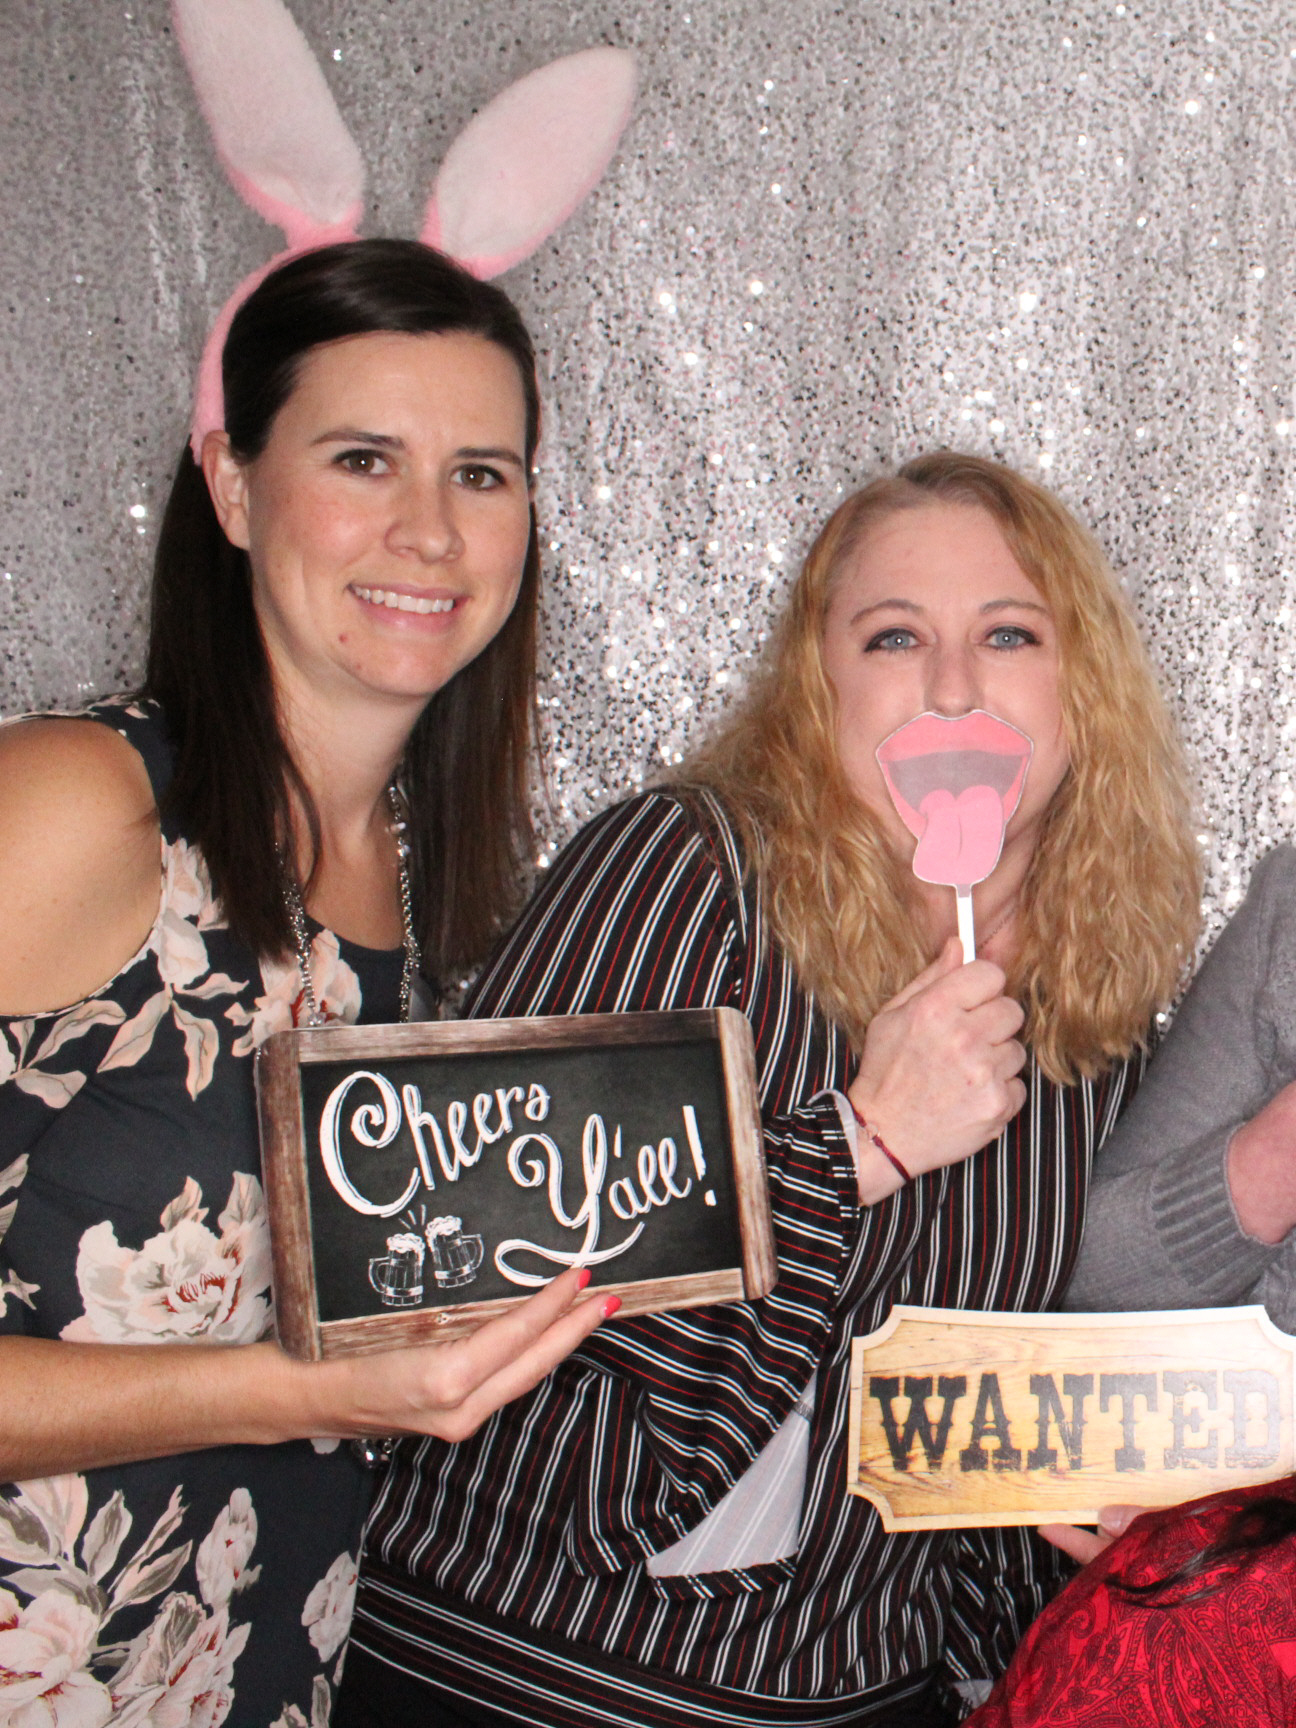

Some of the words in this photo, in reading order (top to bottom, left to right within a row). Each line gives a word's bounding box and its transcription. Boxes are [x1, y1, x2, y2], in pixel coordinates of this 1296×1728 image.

[320, 1071, 550, 1217] Cheers
[494, 1105, 717, 1287] Y'all!
[869, 1369, 1285, 1472] WANTED
